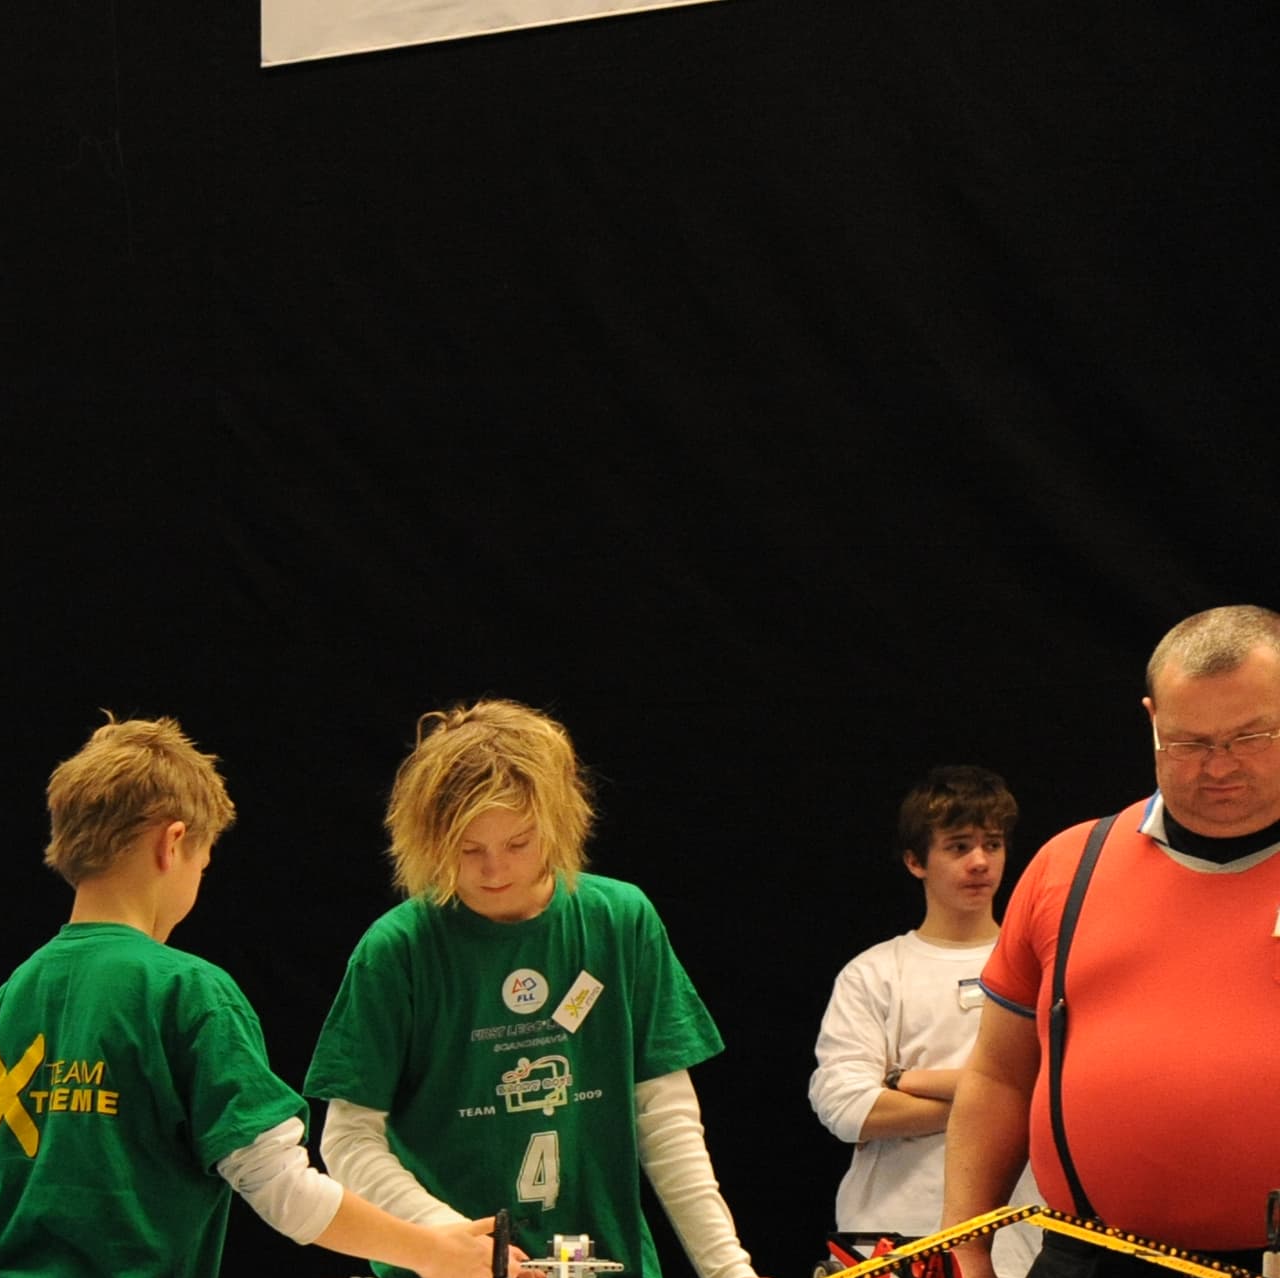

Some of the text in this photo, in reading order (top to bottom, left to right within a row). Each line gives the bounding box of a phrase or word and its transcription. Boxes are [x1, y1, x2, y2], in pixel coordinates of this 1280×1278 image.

[45, 1059, 105, 1086] TEAM
[458, 1105, 496, 1118] TEAM
[516, 1130, 561, 1212] 4
